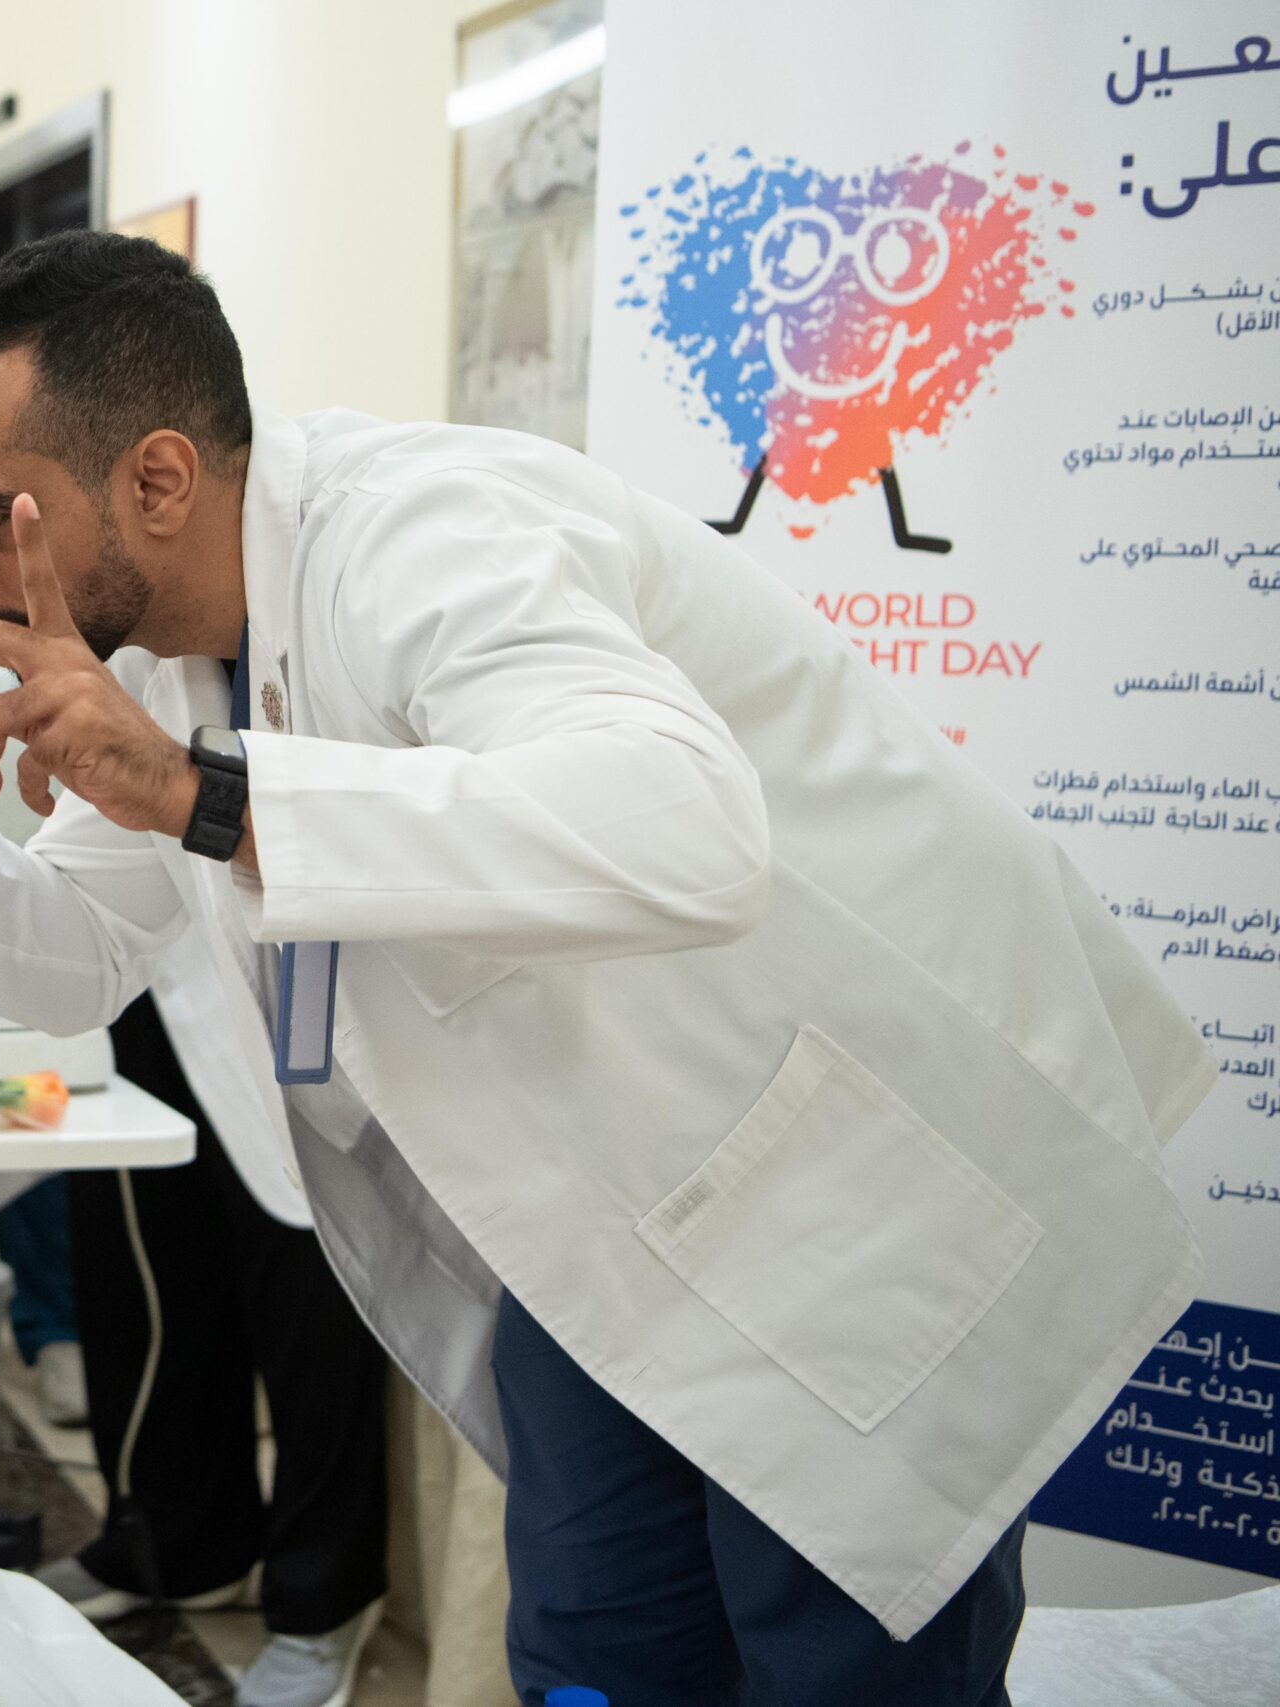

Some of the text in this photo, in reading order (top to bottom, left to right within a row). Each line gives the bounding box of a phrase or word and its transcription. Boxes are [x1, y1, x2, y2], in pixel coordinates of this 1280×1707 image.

[1106, 34, 1280, 106] عين
[1092, 290, 1145, 319] دوري
[1150, 276, 1263, 311] بشكل
[1118, 409, 1158, 430] عند
[1163, 405, 1253, 434] الإصابات
[1063, 439, 1280, 474] ستخدام مواد تحتوي
[1080, 537, 1280, 569] صحي المحتوي على
[800, 592, 976, 628] WORLD
[941, 641, 1042, 677] DAY
[1114, 669, 1201, 698] الشمس
[1205, 666, 1265, 694] أشعة
[1033, 768, 1100, 795] قطرات
[1103, 773, 1207, 802] واستخدام
[1212, 777, 1261, 800] الماء
[1098, 805, 1157, 831] لتجنب
[1165, 807, 1228, 834] الحاجة
[1232, 813, 1270, 833] عند
[1232, 908, 1280, 936] راض
[1162, 937, 1280, 969] ضغط الدم
[1247, 1091, 1280, 1119] رك
[1209, 1174, 1280, 1205] دخين
[1199, 1374, 1274, 1419] يحدث
[1105, 1402, 1275, 1456] استخدام
[1105, 1443, 1280, 1501] ذكية وذلك
